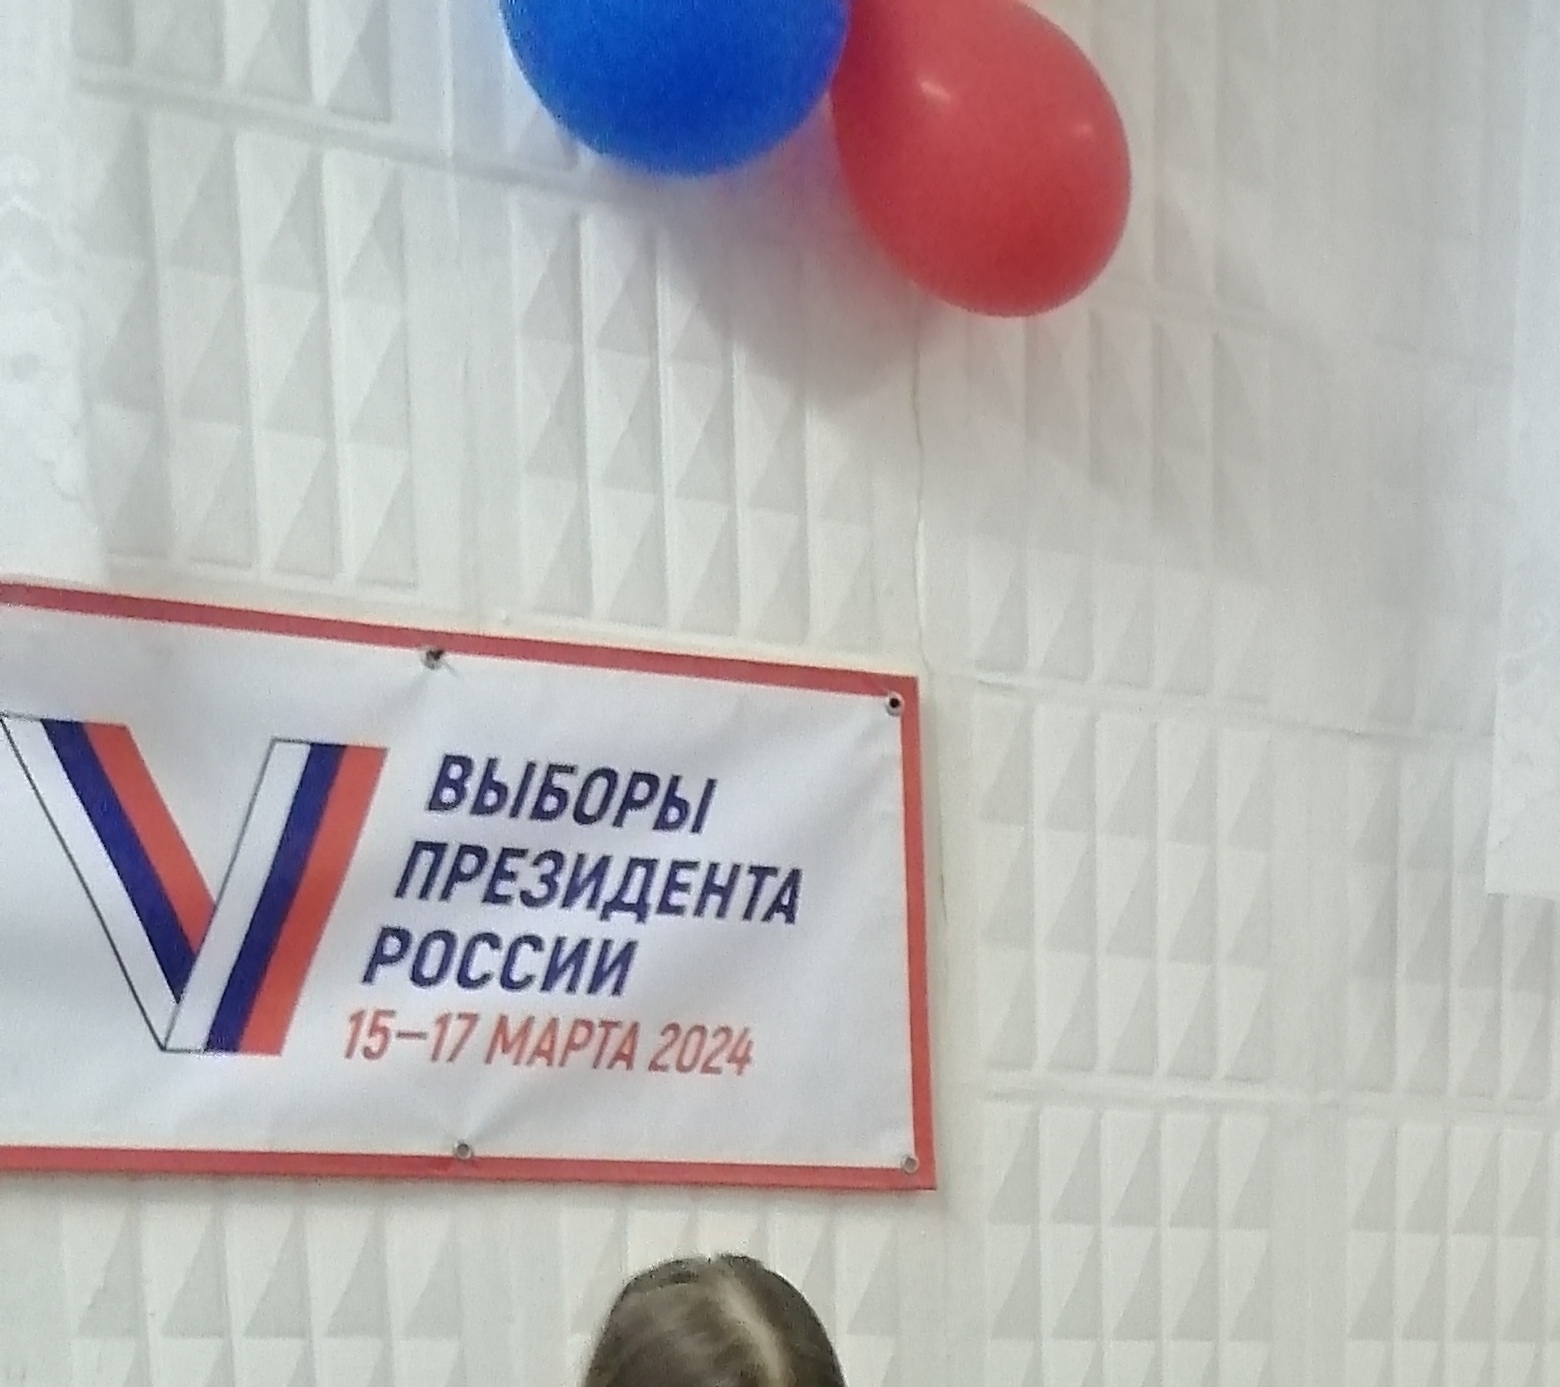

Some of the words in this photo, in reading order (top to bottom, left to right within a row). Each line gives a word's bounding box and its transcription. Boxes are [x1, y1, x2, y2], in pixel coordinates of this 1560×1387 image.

[426, 754, 718, 834] ВЫБОРЫ
[394, 840, 804, 925] ПРЕЗИДЕНТА
[361, 926, 640, 997] РОССИИ
[483, 1013, 642, 1072] МАРТА
[647, 1021, 755, 1077] 2024
